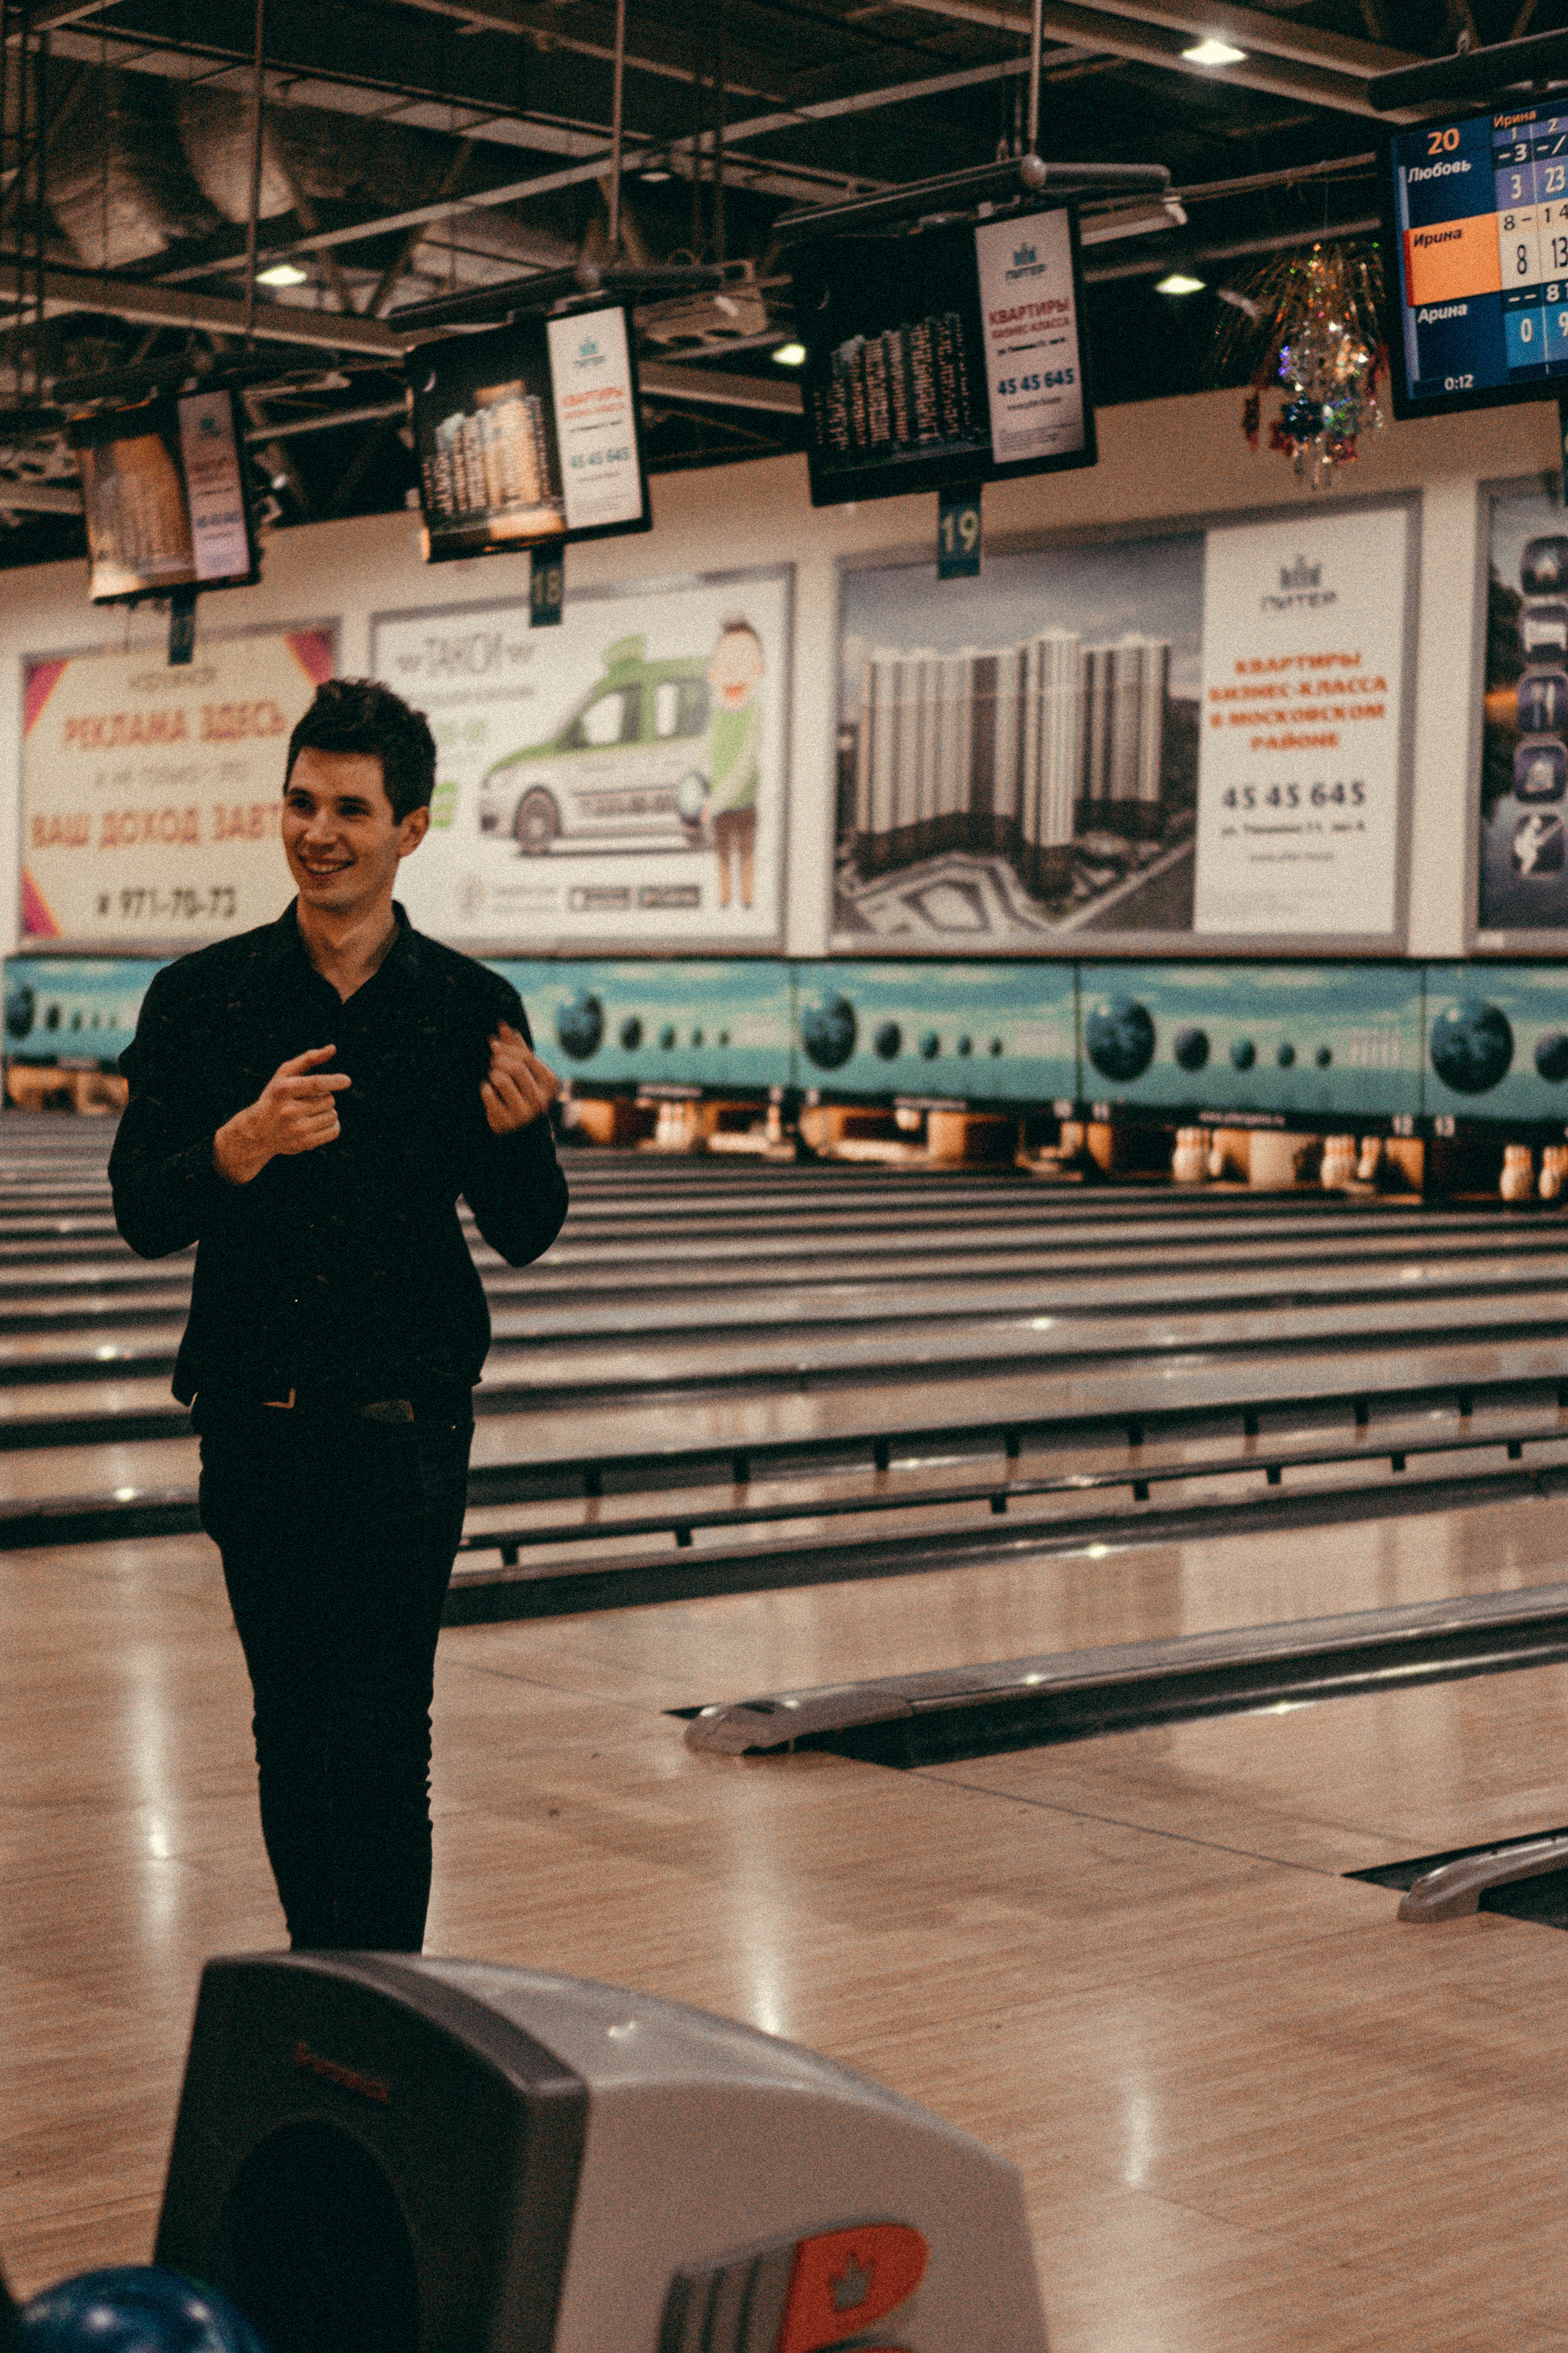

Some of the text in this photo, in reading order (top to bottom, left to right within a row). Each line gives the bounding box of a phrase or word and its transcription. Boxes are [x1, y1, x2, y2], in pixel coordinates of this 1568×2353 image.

[1493, 110, 1537, 129] Ирина
[1511, 118, 1559, 141] 1 2
[1427, 127, 1460, 155] 20
[1407, 160, 1472, 183] Любовь
[1511, 164, 1566, 200] 3 23
[1414, 229, 1462, 248] Ирина
[1517, 236, 1568, 274] 8 13
[989, 297, 1070, 324] КВАРТИРЫ
[1417, 304, 1468, 324] Арина
[1520, 317, 1533, 343] 0
[998, 368, 1075, 395] 45 45 645
[1444, 373, 1474, 391] 0:12
[941, 510, 979, 551] 19
[1235, 651, 1362, 675] КВАРТИРЫ
[64, 699, 287, 752] РЕКЛАМА ЗДЕСЬ
[1229, 704, 1386, 727] МОСКОВСКОМ
[1250, 731, 1339, 751] РАЙОНЕ
[1222, 779, 1366, 810] 45 45 645
[31, 802, 283, 851] ВАШ ДОХОД ЗАВТ
